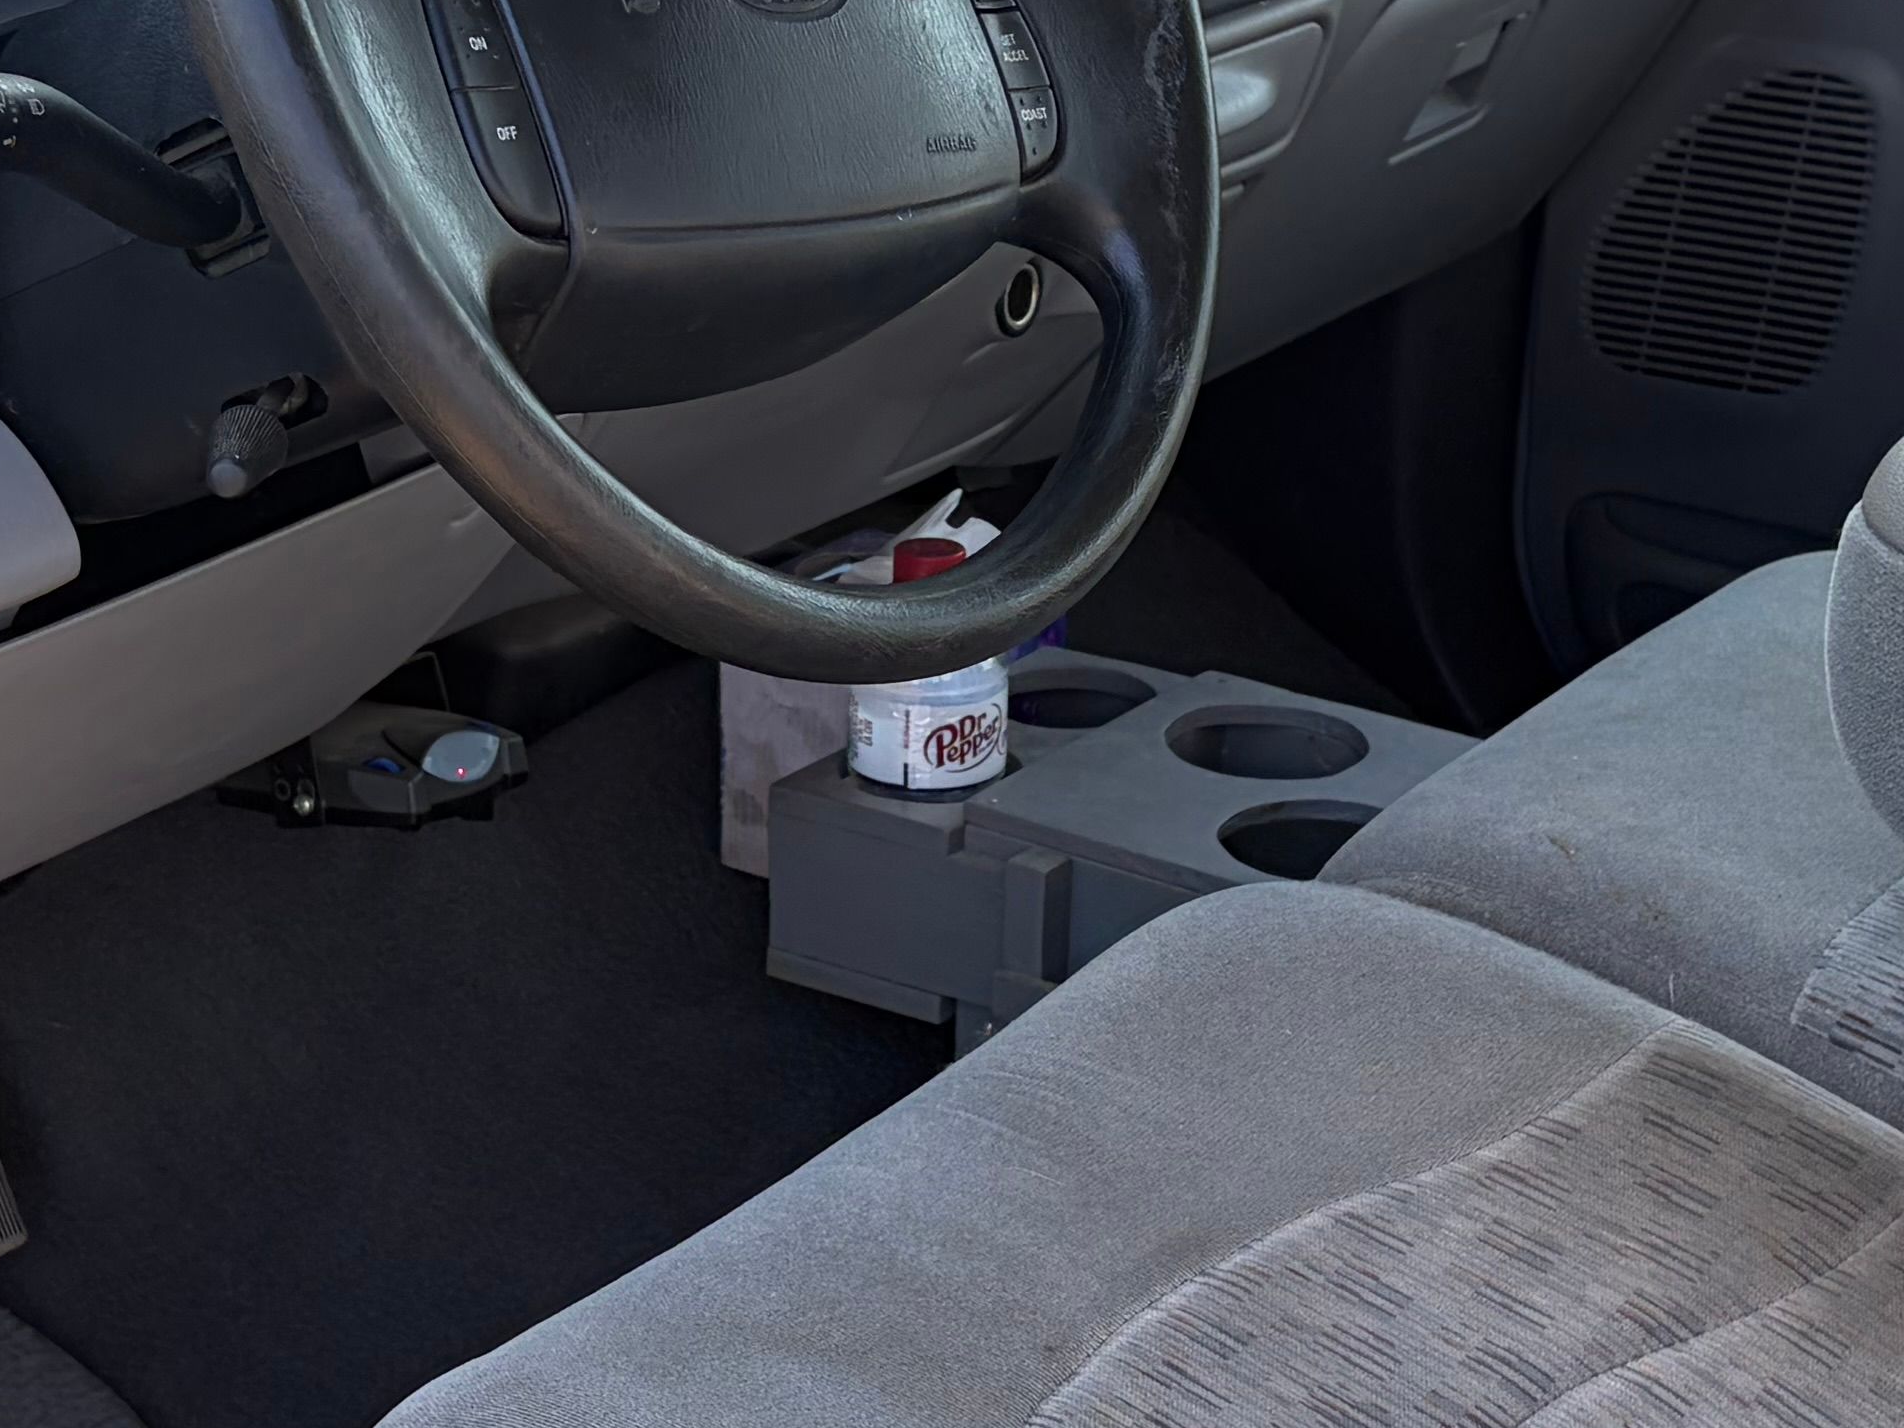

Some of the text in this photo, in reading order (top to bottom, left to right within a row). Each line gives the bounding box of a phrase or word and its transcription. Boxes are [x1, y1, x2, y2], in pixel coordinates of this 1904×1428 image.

[468, 36, 488, 52] ON
[1000, 33, 1016, 47] SET
[1021, 106, 1048, 121] COAST
[496, 125, 518, 142] OFF
[926, 134, 977, 154] AIRBAG
[959, 712, 987, 739] Dr
[934, 715, 999, 769] Pepper
